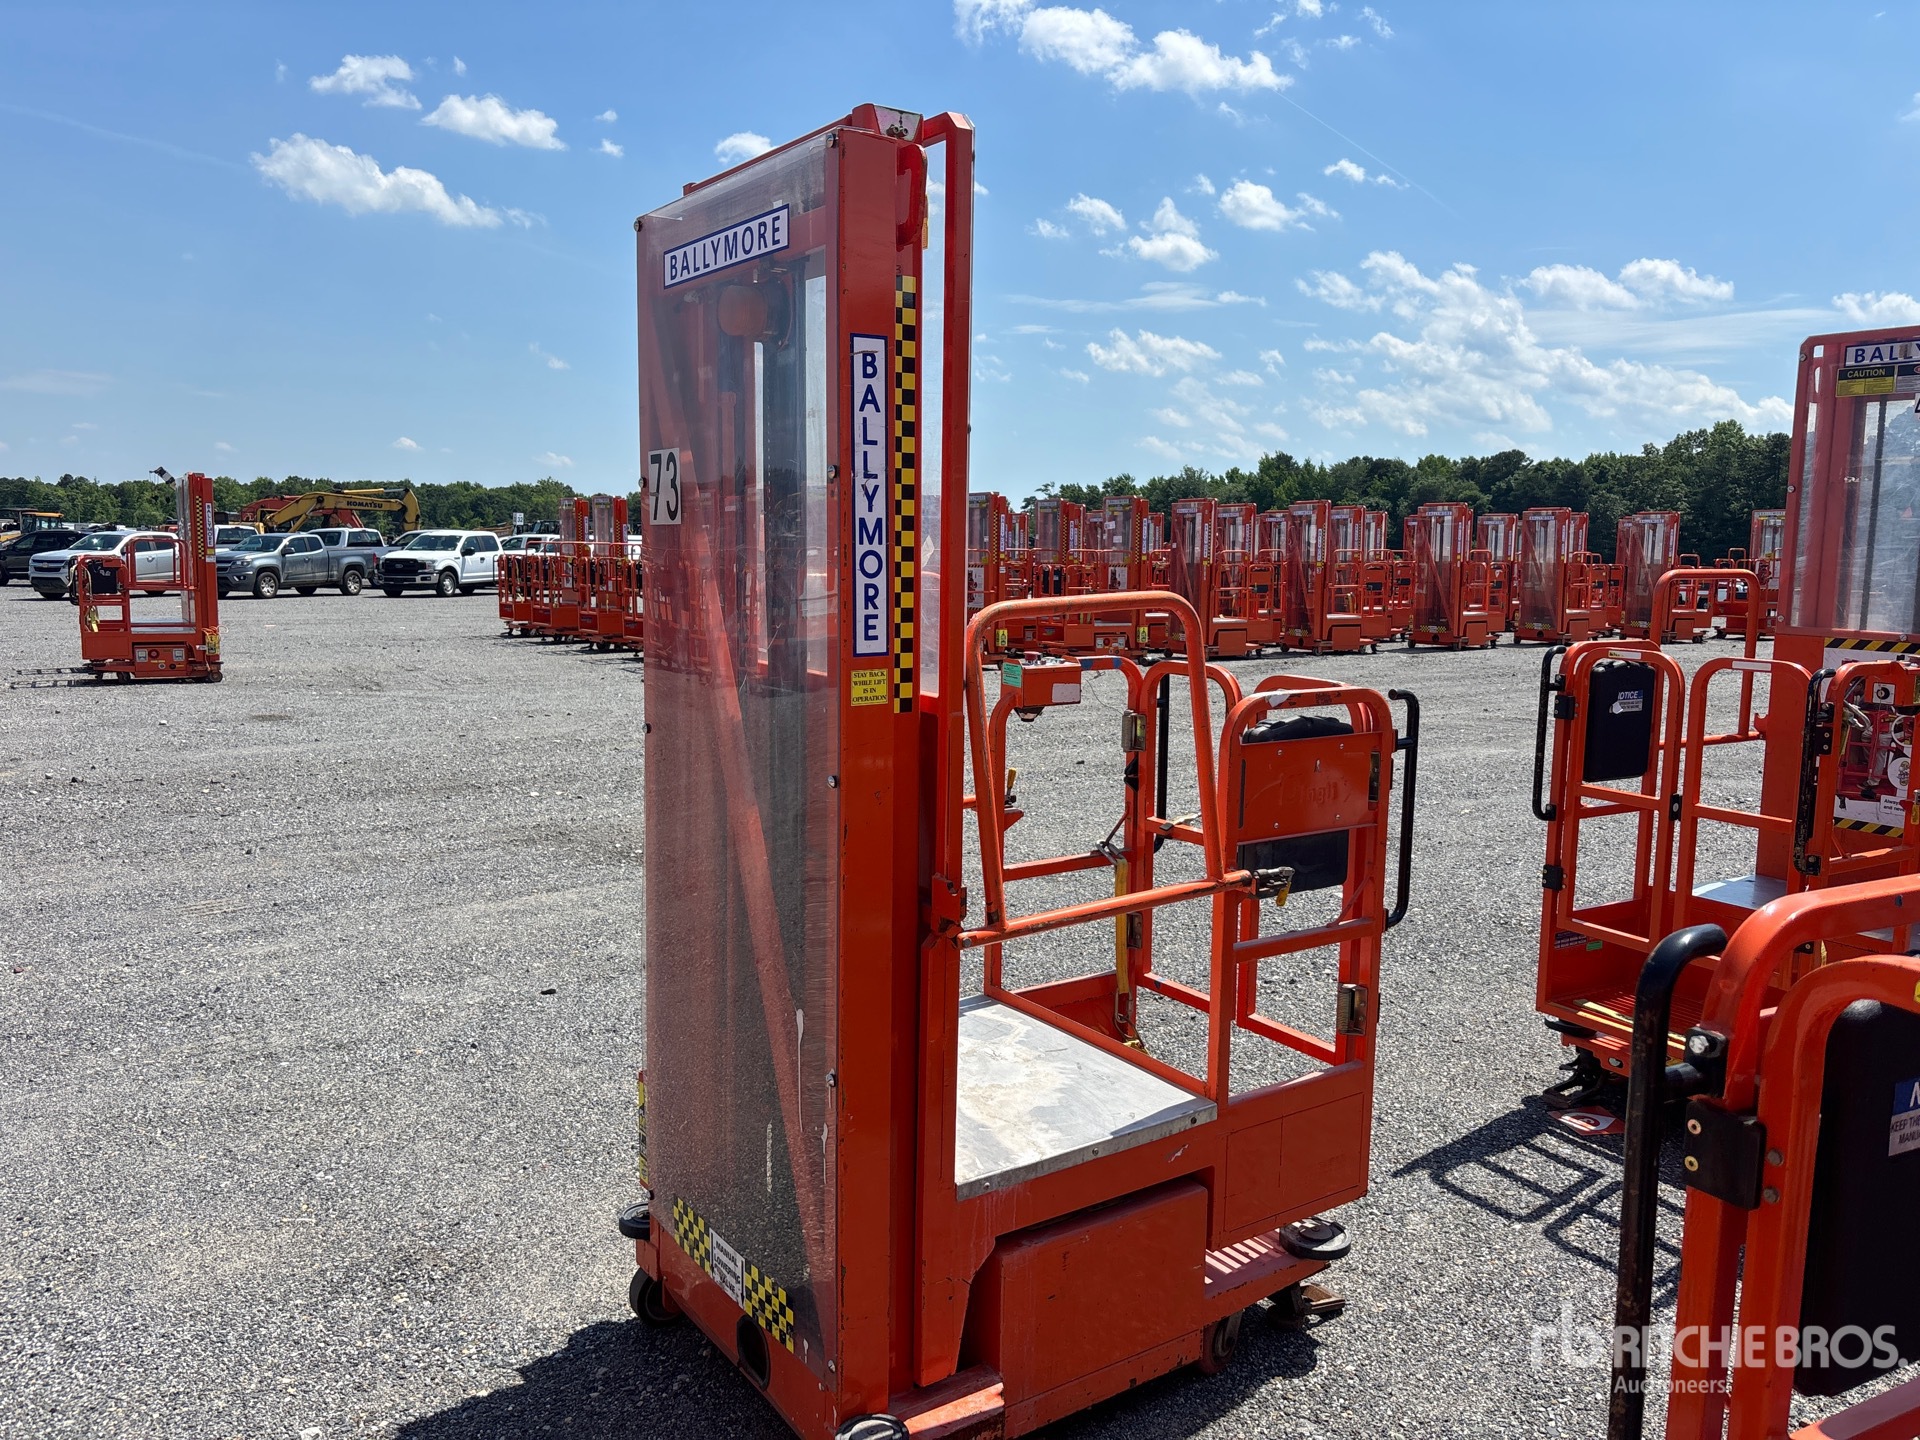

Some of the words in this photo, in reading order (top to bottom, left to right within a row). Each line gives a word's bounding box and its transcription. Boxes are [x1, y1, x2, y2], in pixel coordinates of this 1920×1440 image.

[670, 215, 780, 281] BALLYMORE
[1847, 368, 1886, 378] CAUTION
[650, 451, 679, 521] 73
[858, 352, 883, 641] BALLYMORE
[346, 500, 383, 509] KOMATSU
[714, 1253, 741, 1284] LOWERING
[715, 1240, 738, 1268] MANUAL
[719, 1272, 735, 1293] VALVE
